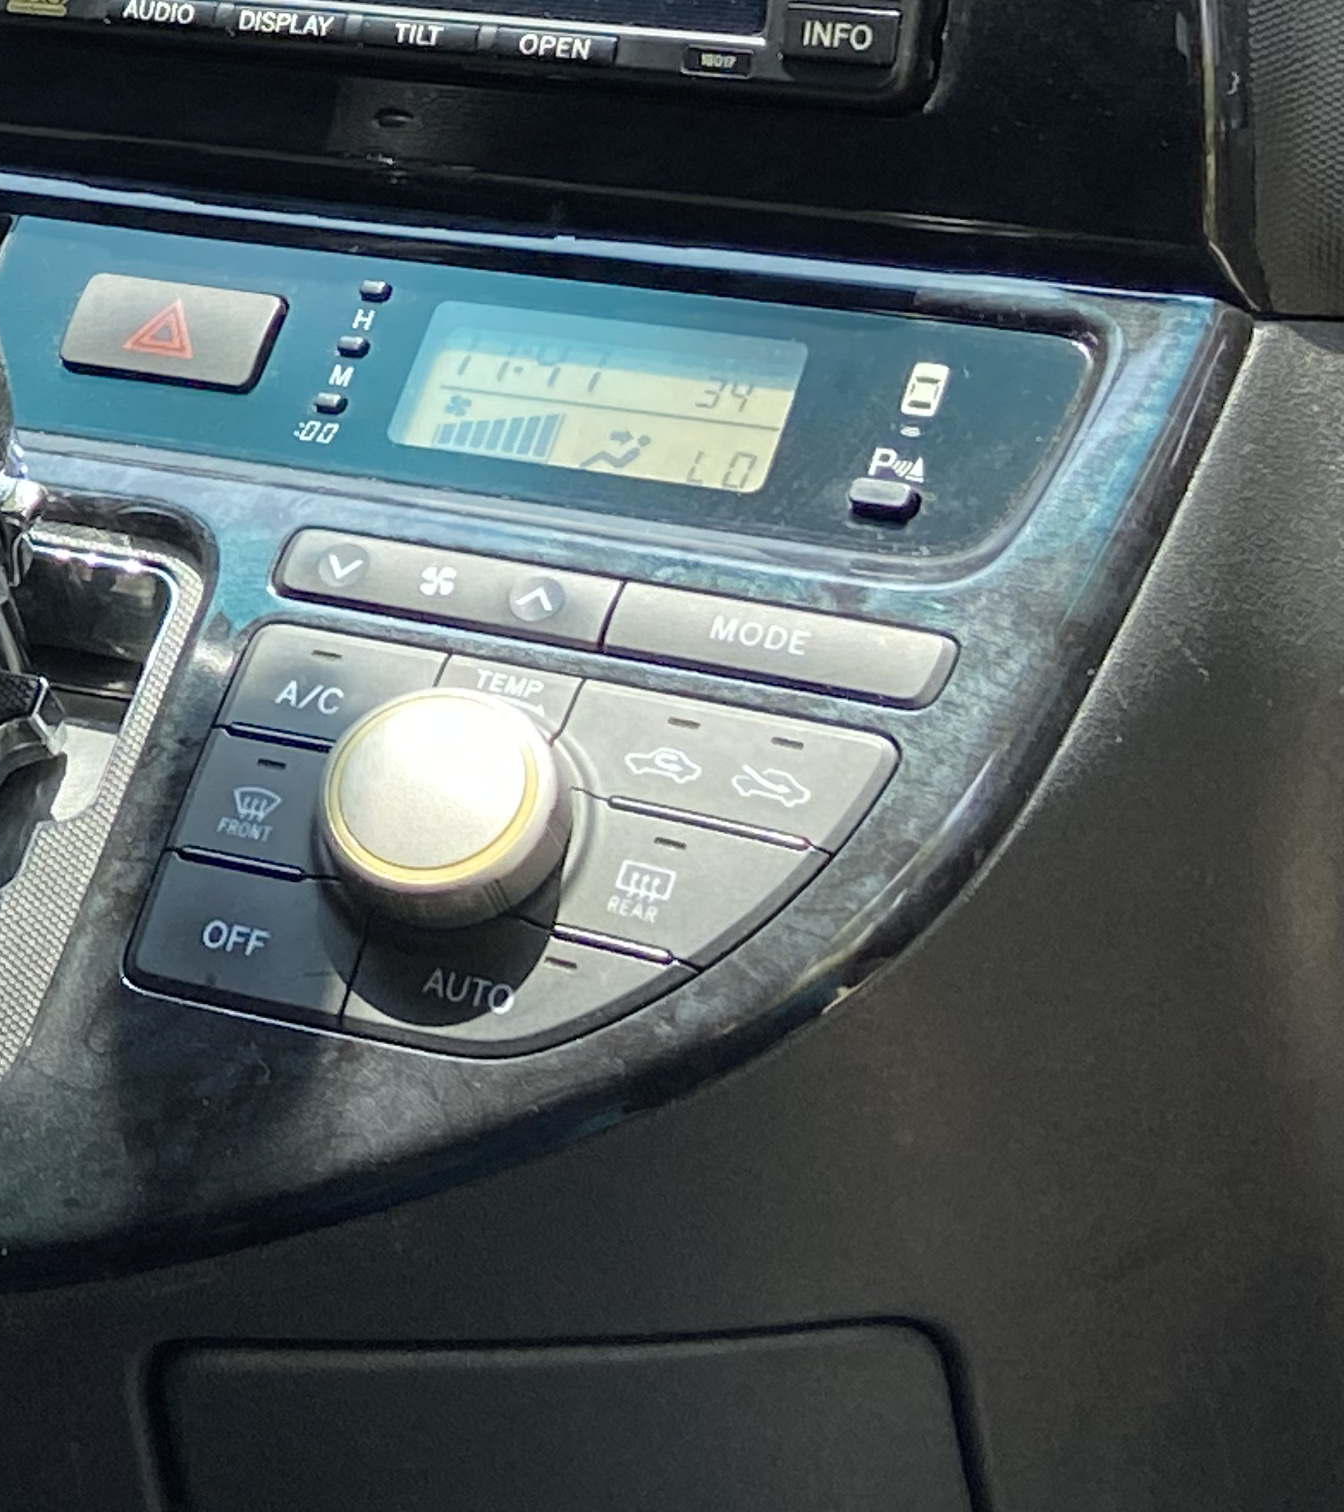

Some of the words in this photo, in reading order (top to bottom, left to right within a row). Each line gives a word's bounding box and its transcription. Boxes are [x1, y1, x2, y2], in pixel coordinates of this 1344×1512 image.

[238, 10, 335, 39] DISPLAY
[394, 22, 444, 47] TILT
[802, 22, 874, 53] INFO
[518, 33, 592, 60] OPEN
[351, 308, 376, 331] H
[328, 364, 354, 388] M
[709, 614, 812, 657] MODE
[275, 679, 346, 716] A/C
[476, 667, 546, 700] TEMP
[216, 816, 274, 843] FRONT
[607, 897, 659, 924] REAR
[201, 919, 271, 958] OFF
[421, 964, 515, 1016] AUTO
